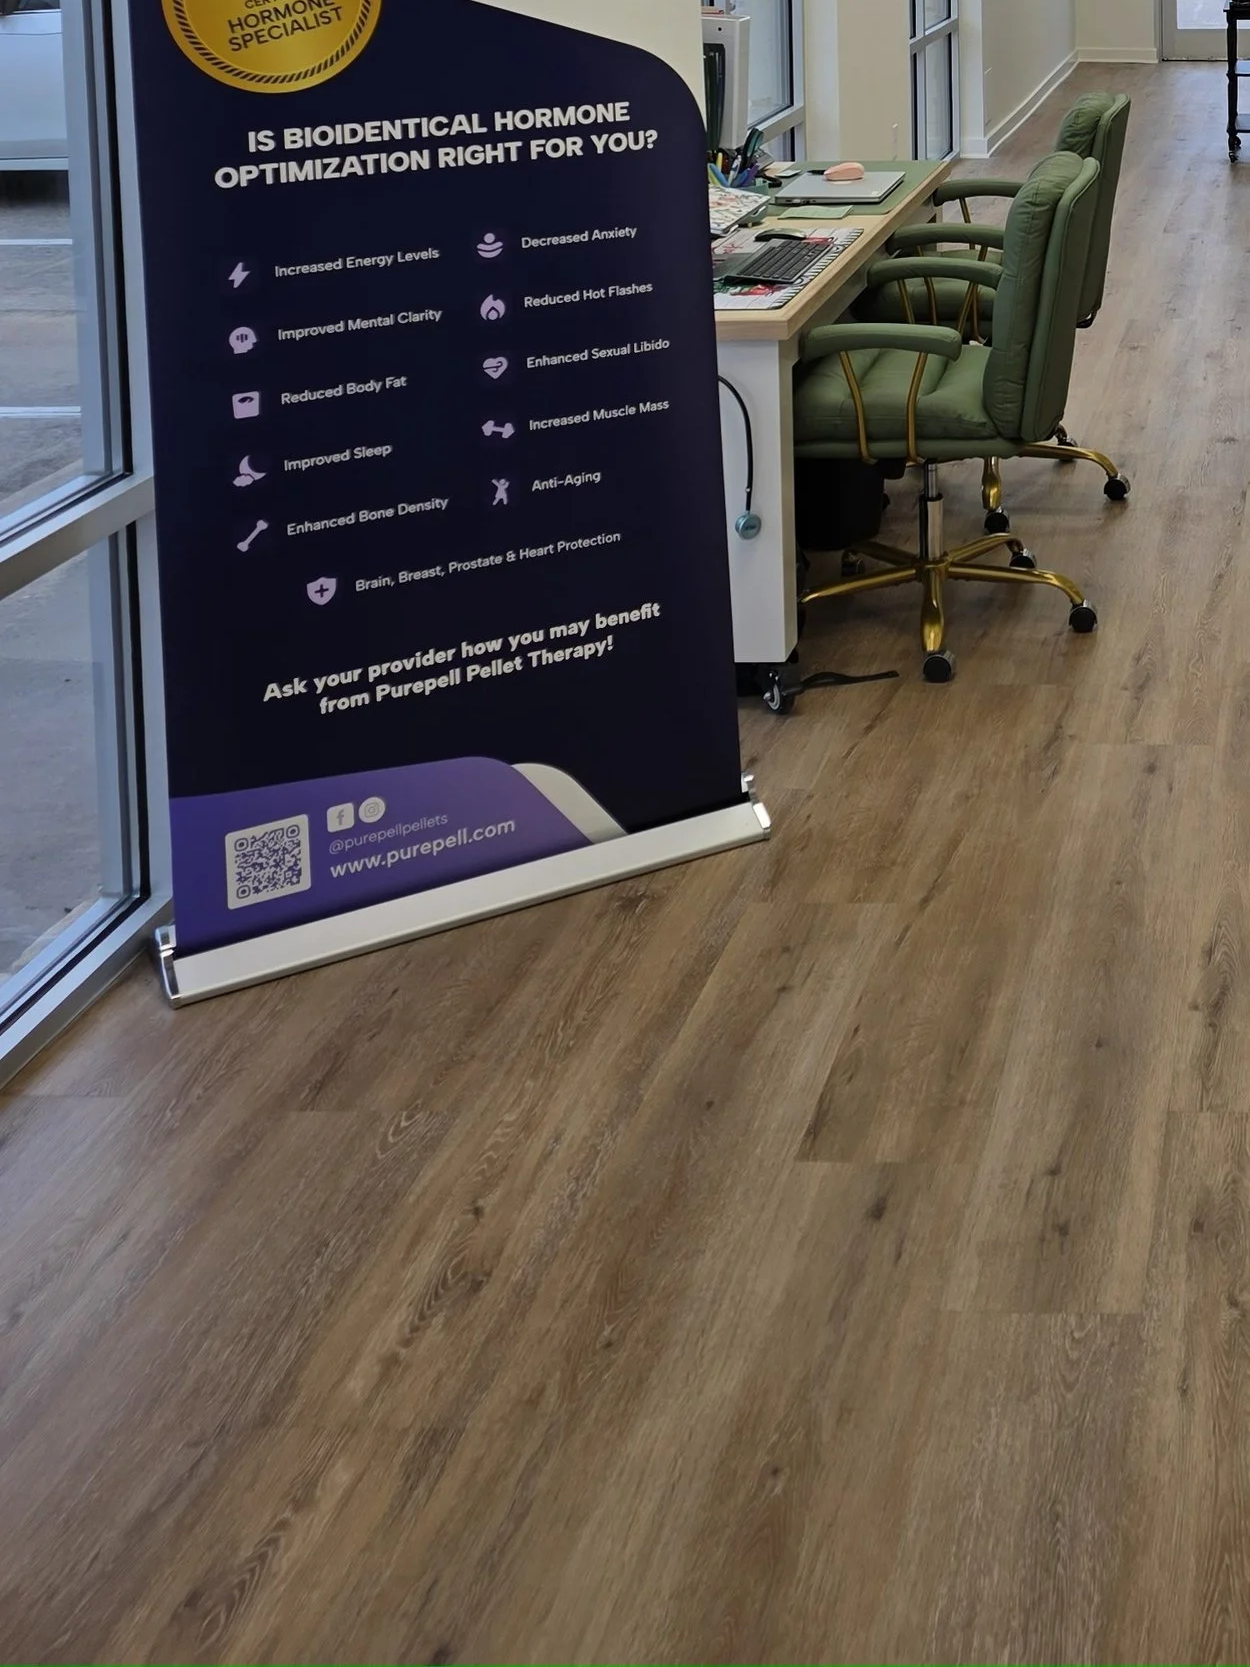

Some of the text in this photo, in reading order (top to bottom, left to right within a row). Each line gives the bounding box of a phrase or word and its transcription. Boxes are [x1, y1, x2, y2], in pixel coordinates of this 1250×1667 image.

[228, 6, 342, 52] SPECIALIST
[248, 101, 630, 152] IS BIOIDENTICAL HORMONE
[215, 129, 658, 188] OPTIMIZATION RIGHT FOR YOU?
[521, 227, 637, 248] Decreased Anxiety
[275, 248, 440, 277] Increased Energy Levels
[524, 283, 653, 308] Reduced Hot Flashes
[278, 309, 442, 341] Improved Mental Clarity
[527, 339, 670, 368] Enhanced Sexual Libido
[281, 376, 407, 405] Reduced Body Fat
[529, 401, 669, 430] Increased Muscle Mass
[284, 445, 392, 471] Improved Sleep
[532, 472, 601, 491] Anti-Aging
[287, 498, 448, 535] Enhanced Bone Density
[356, 533, 620, 592] Brain, Breast, Prostate & Heart Protection
[263, 603, 660, 702] Ask your provider how you may benefit
[319, 635, 613, 714] from Purepell Pellet Therapy!
[329, 815, 448, 854] @purepellpellets
[329, 820, 515, 878] www.purepell.com
